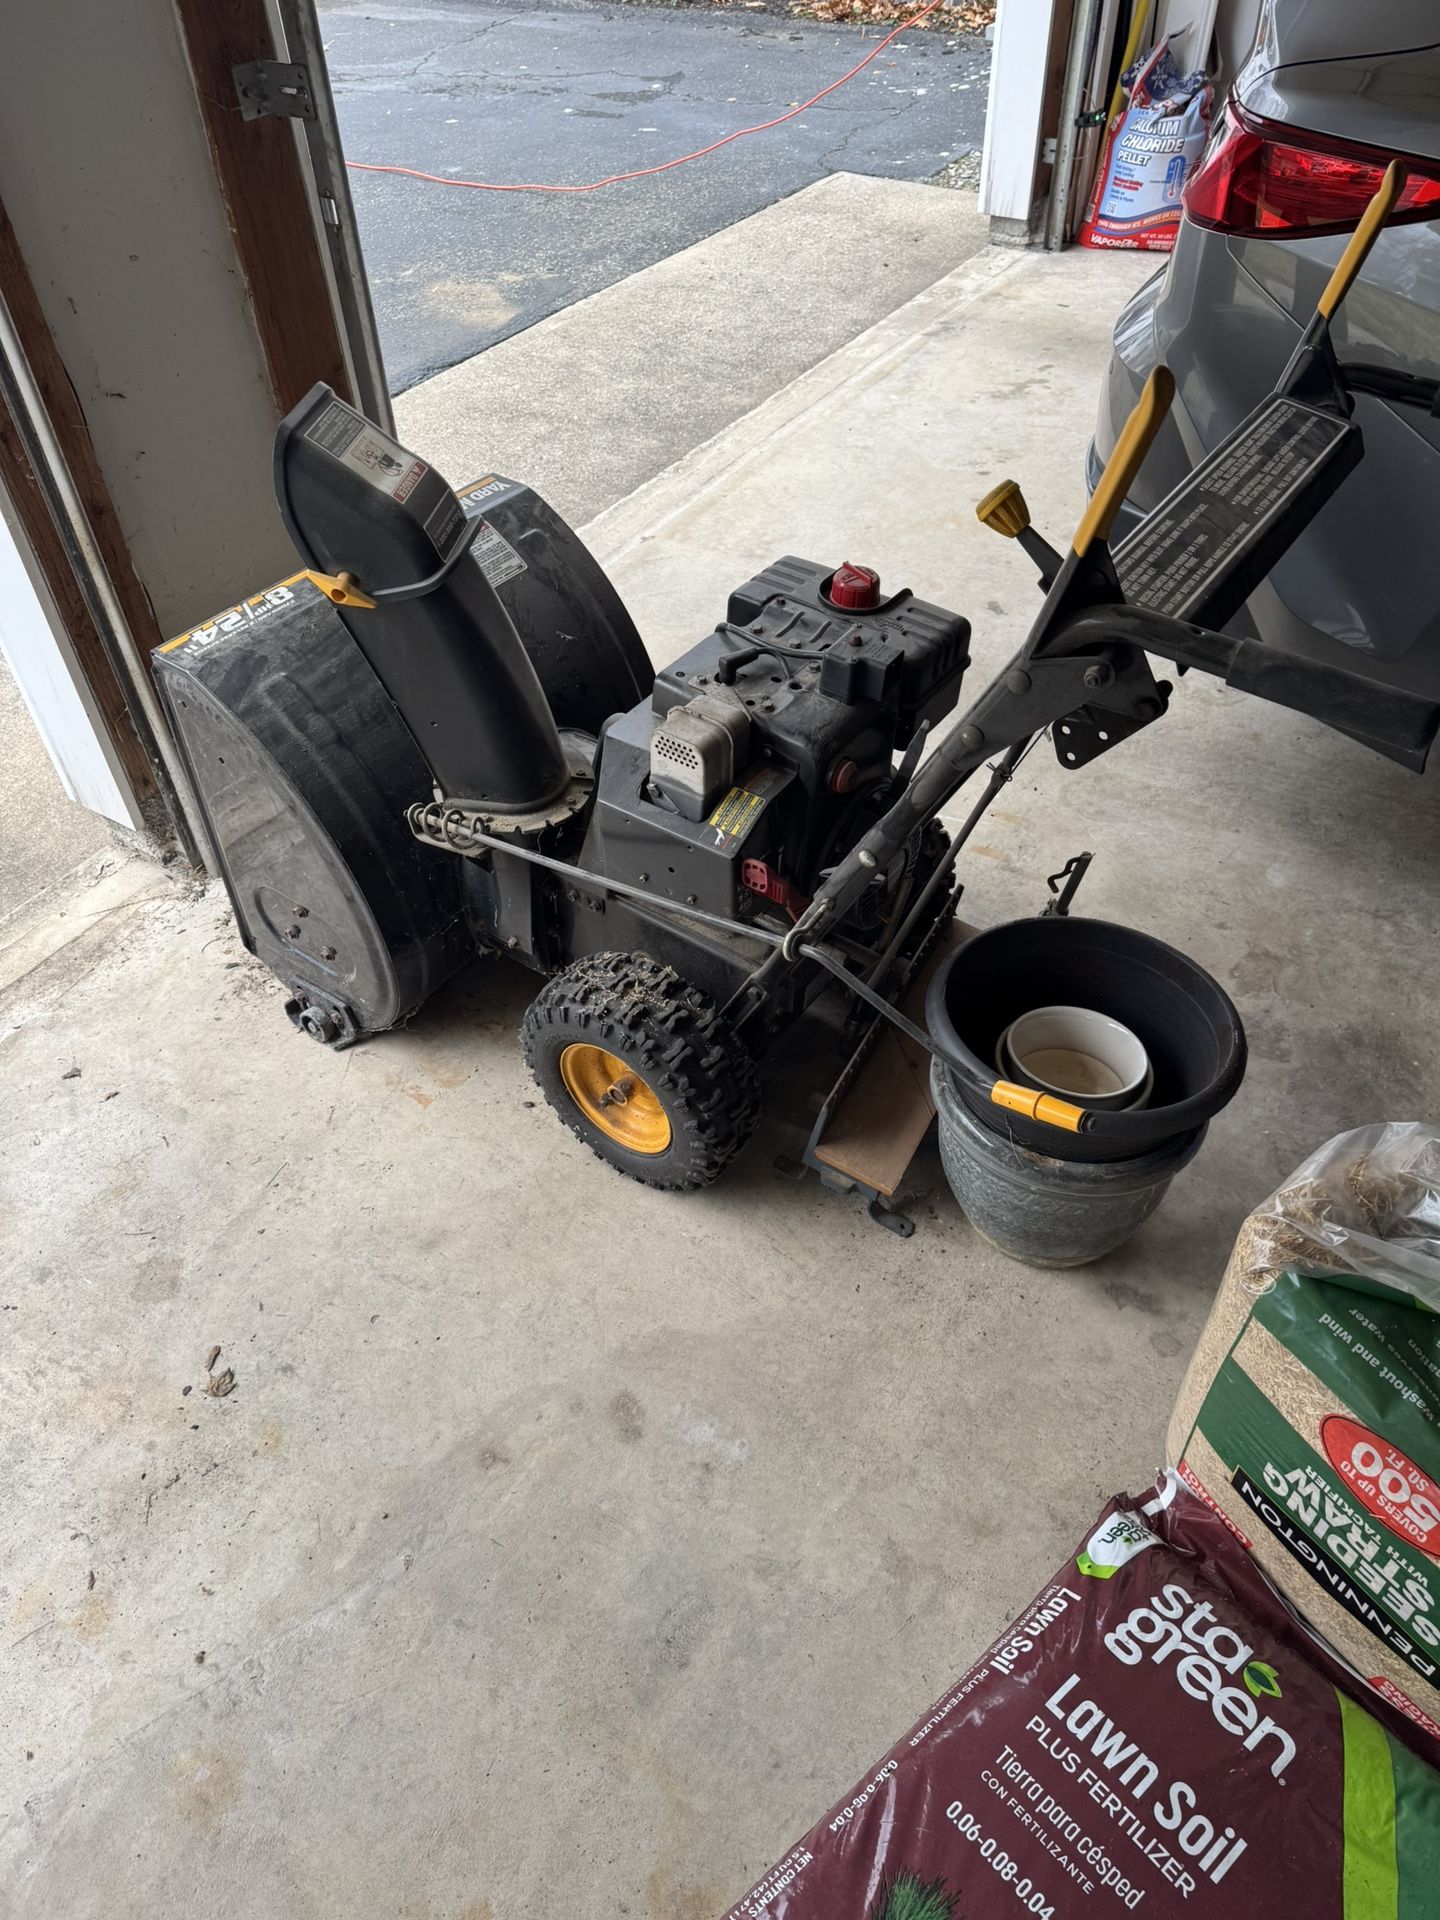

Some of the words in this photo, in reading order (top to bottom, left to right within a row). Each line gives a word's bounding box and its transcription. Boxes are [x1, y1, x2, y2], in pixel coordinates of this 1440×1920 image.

[1121, 134, 1184, 152] CHLORIDE
[1130, 118, 1180, 136] CALCIUM
[1117, 150, 1151, 166] PELLET
[397, 473, 417, 497] DANGER
[469, 480, 511, 500] YARD
[1318, 1313, 1353, 1344] wind
[1349, 1309, 1386, 1342] water
[1352, 1343, 1380, 1367] and
[1379, 1367, 1434, 1421] washout
[1340, 1460, 1357, 1480] TO
[1385, 1448, 1405, 1470] FT.
[1182, 1466, 1246, 1547] CONTROL
[1305, 1465, 1382, 1545] TACKIFIER
[1351, 1441, 1440, 1533] 500
[1357, 1479, 1375, 1496] UP
[1285, 1468, 1435, 1613] STRAW
[1377, 1497, 1428, 1543] COVERS
[1263, 1462, 1440, 1646] SEEDING
[1385, 1545, 1429, 1587] WITH
[1242, 1481, 1437, 1677] PENNINGTON
[1024, 1587, 1082, 1637] Lawn
[1150, 1584, 1255, 1676] sta
[989, 1636, 1034, 1675] Soil
[961, 1668, 989, 1693] PLUS
[1104, 1607, 1297, 1778] green
[908, 1692, 964, 1747] FERTILIZER
[1045, 1673, 1160, 1799] Lawn
[1153, 1781, 1248, 1884] Soil
[993, 1745, 1044, 1802] Tierra
[1035, 1795, 1080, 1843] para
[1077, 1836, 1146, 1910] césped
[1026, 1715, 1081, 1773] PLUS
[1077, 1767, 1196, 1899] FERTILIZER
[981, 1770, 1006, 1799] CON
[1007, 1796, 1095, 1895] FERTILIZANTE
[768, 1871, 781, 1883] FT
[780, 1859, 793, 1872] CU
[794, 1851, 814, 1872] NET
[945, 1800, 1056, 1920] 0.06-0.08-0.04
[748, 1870, 796, 1918] CONTENTS
